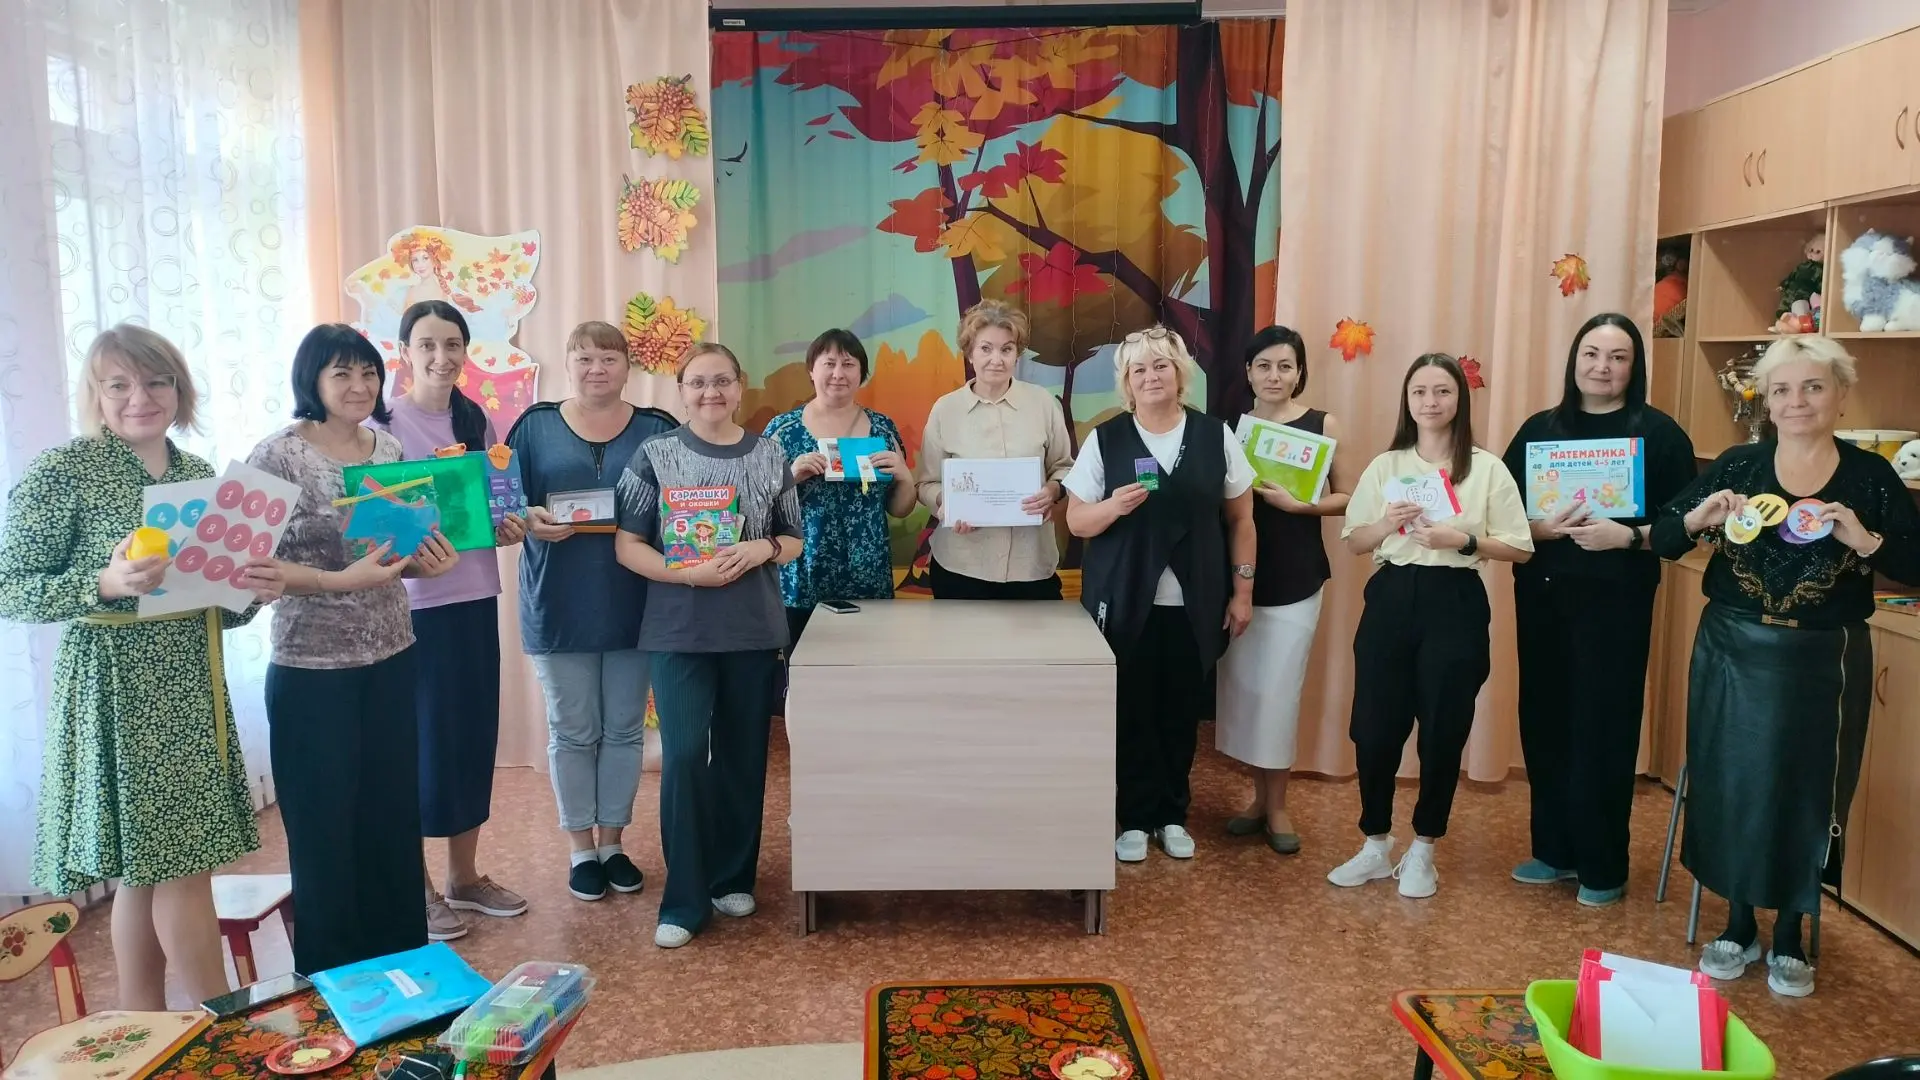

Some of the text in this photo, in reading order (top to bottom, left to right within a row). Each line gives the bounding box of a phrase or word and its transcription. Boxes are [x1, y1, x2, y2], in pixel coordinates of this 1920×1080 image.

[1263, 438, 1274, 455] 1
[1276, 441, 1288, 458] 2
[1300, 446, 1312, 464] 5
[1550, 449, 1626, 460] МАТЕМАТИКА
[511, 478, 519, 489] 5
[1602, 483, 1614, 497] 5
[1573, 488, 1587, 503] 4
[224, 490, 279, 518] 1 6 3
[157, 509, 200, 523] 4 5
[675, 520, 687, 532] 5
[206, 523, 265, 553] 8 2 5
